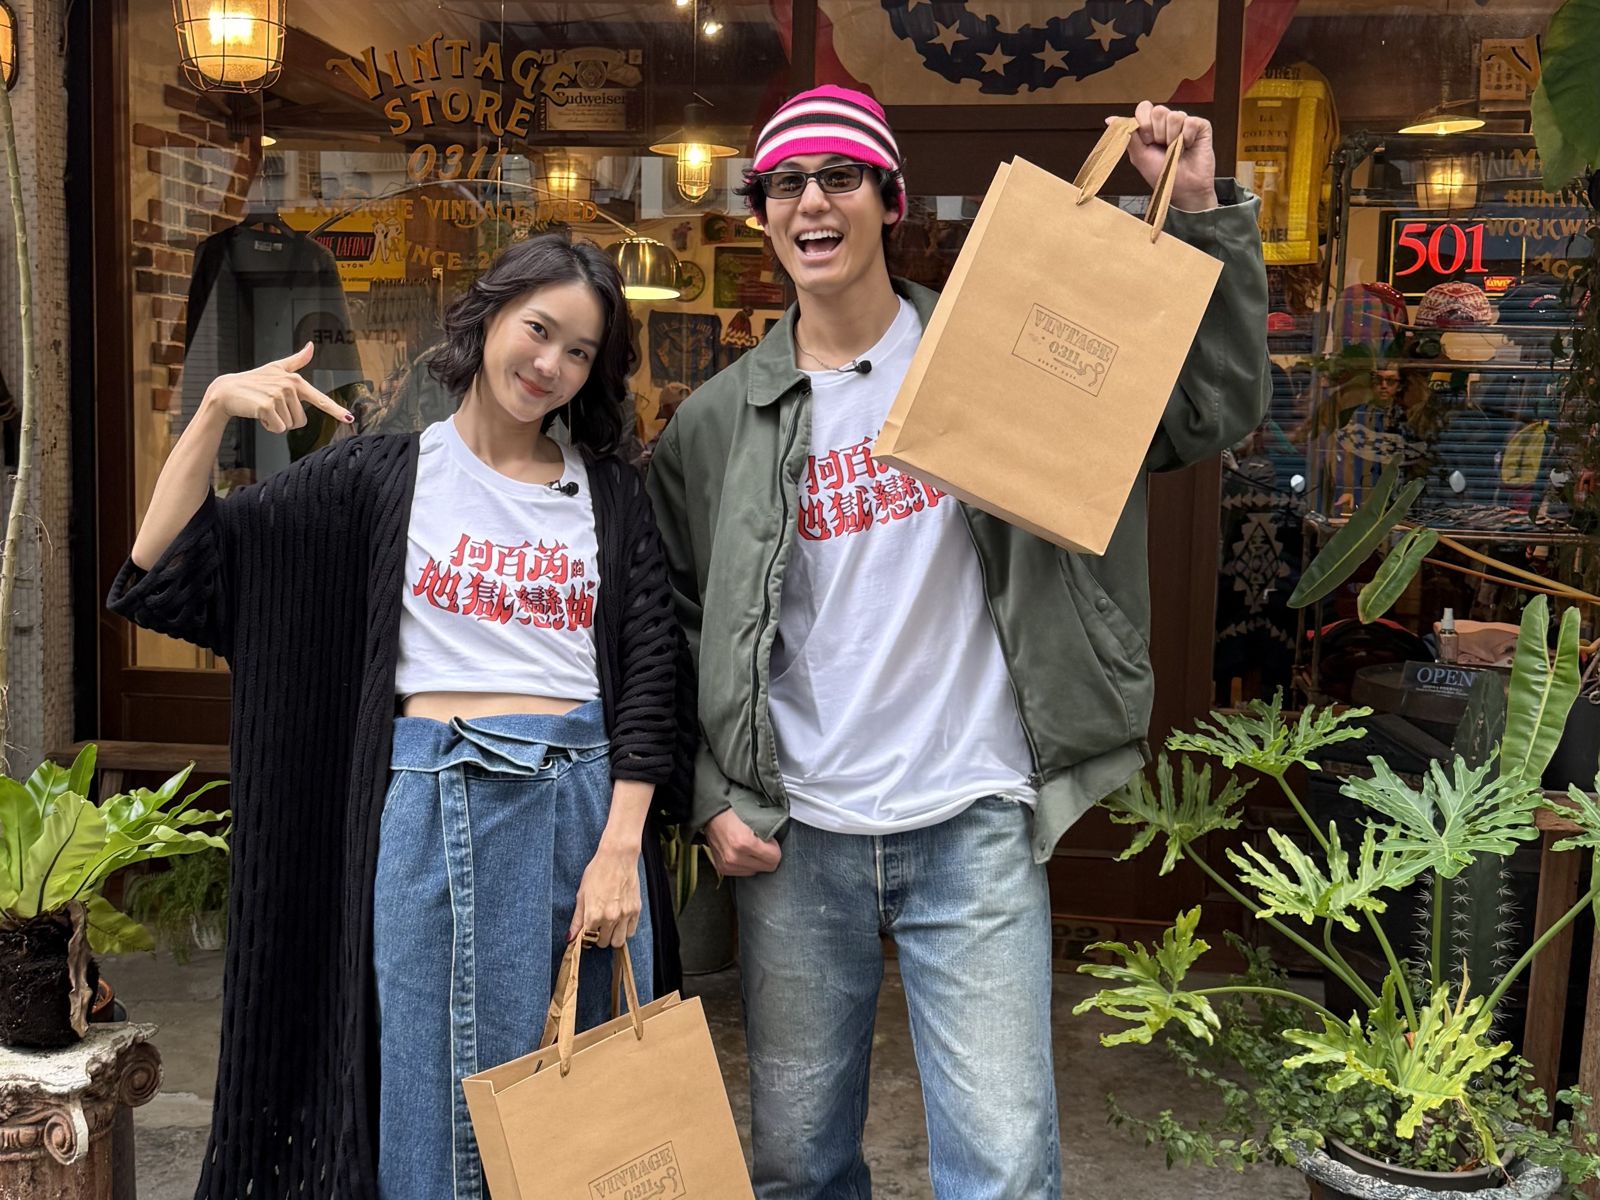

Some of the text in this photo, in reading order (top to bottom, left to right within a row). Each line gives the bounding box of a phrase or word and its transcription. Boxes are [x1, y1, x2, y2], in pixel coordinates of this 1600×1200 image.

[326, 31, 577, 106] VINTAGE
[384, 86, 536, 138] STORE
[407, 143, 508, 181] 0311
[1512, 148, 1544, 172] M
[420, 195, 530, 226] VINTAGE
[537, 200, 598, 222] USED
[1486, 218, 1594, 240] WORKW
[336, 236, 375, 257] LAFONT
[1395, 223, 1489, 276] 501
[1035, 309, 1114, 363] VINTAGE
[805, 436, 889, 496] 何百
[1416, 667, 1477, 687] OPEN
[593, 1147, 673, 1199] VINTAGE
